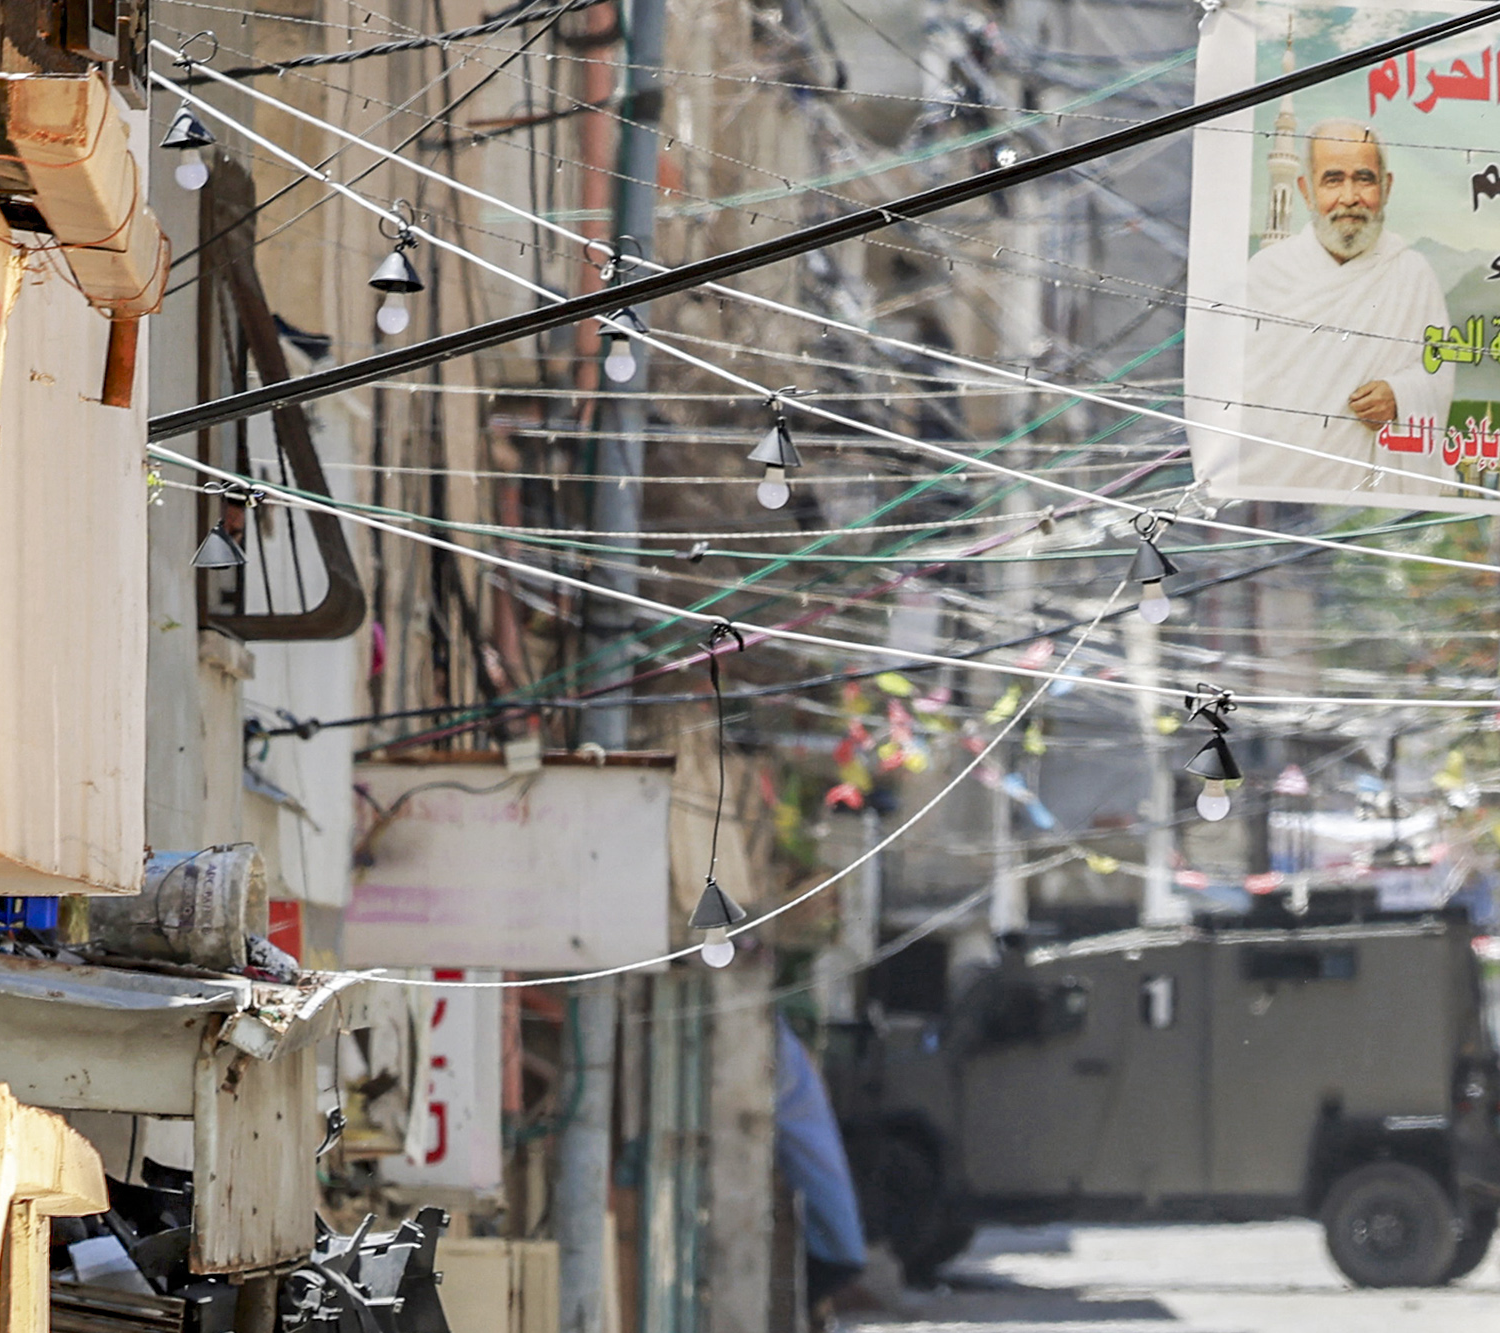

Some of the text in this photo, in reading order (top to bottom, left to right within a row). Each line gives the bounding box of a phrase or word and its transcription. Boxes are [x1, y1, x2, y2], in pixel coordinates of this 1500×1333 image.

[1421, 313, 1487, 375] الحج
[1377, 414, 1436, 457] الله
[1142, 976, 1175, 1029] 1
